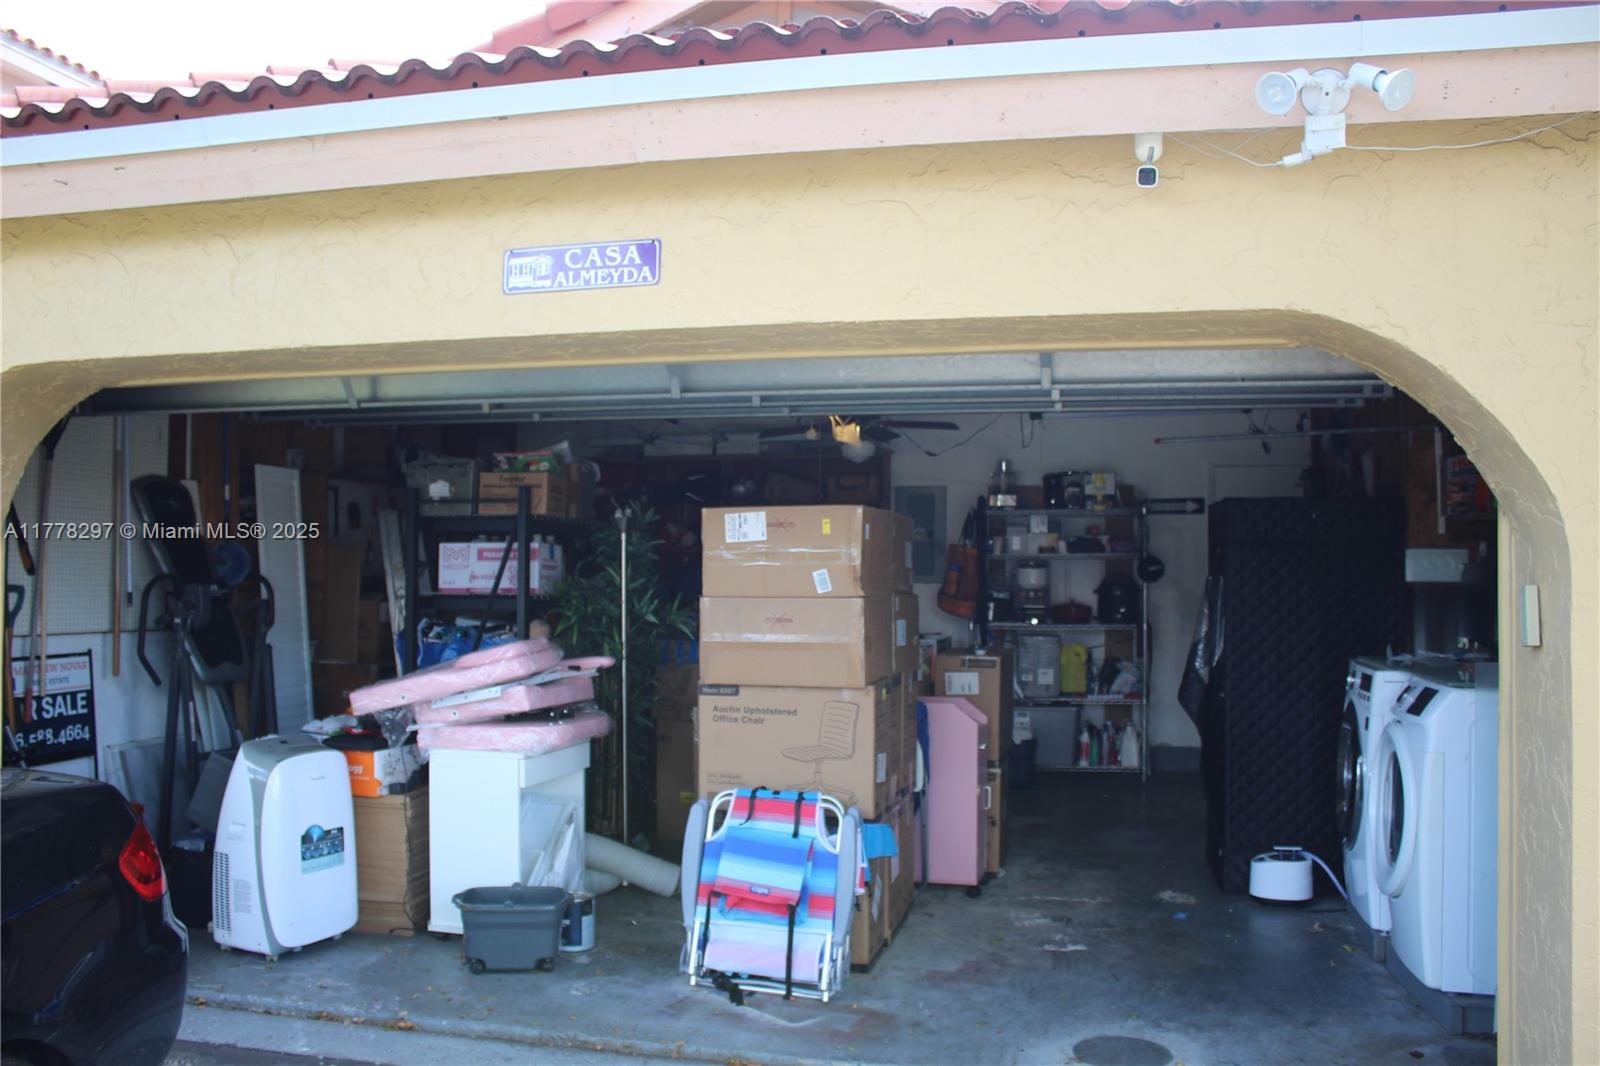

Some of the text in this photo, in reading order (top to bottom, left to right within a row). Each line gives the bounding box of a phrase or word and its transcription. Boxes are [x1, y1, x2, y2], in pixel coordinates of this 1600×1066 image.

[564, 245, 641, 268] CASA
[553, 266, 653, 287] ALMEYDA
[41, 692, 88, 719] SALE
[743, 706, 798, 716] Upholstered
[712, 714, 765, 725] Office Chair
